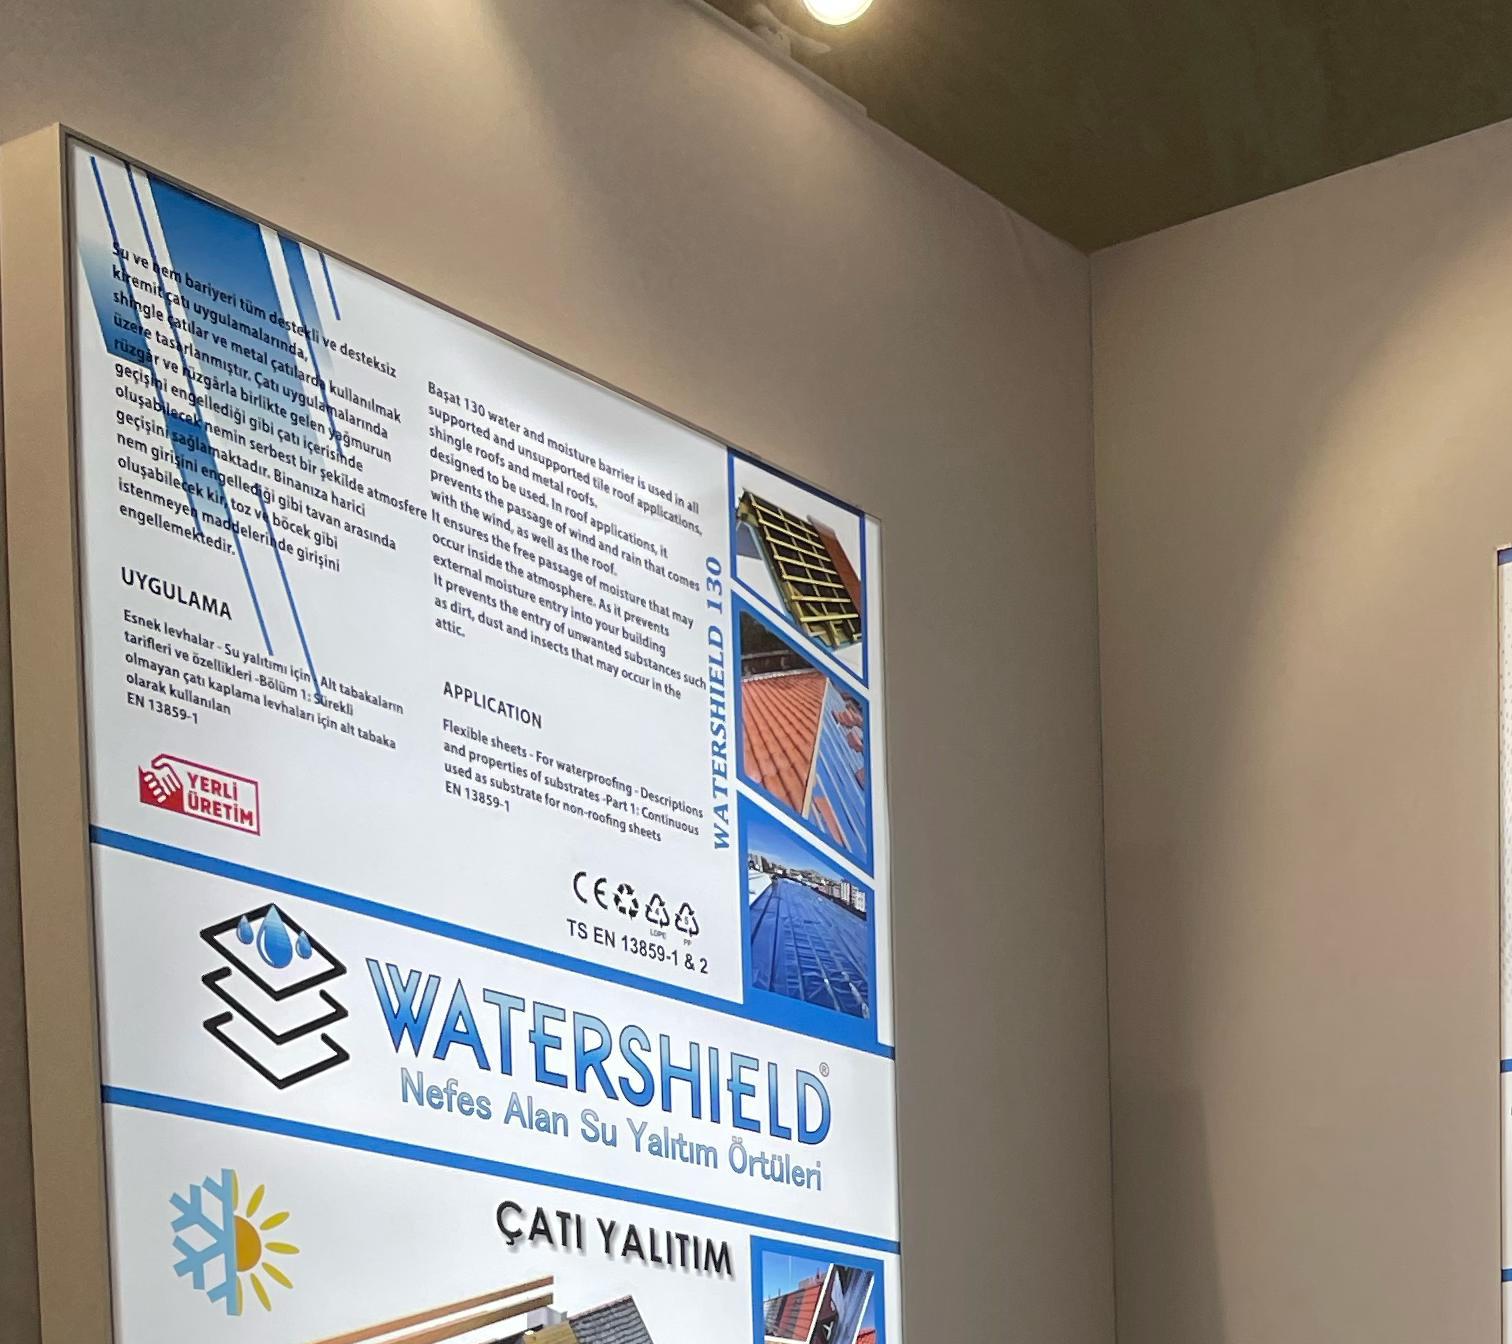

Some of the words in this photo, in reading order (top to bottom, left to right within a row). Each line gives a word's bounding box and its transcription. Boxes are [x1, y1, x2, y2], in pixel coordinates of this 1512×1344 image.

[114, 313, 151, 339] üzere
[254, 371, 279, 392] Çatı
[203, 422, 246, 446] nemin
[250, 440, 296, 466] serbest
[300, 457, 316, 474] bir
[321, 468, 364, 493] şekilde
[367, 486, 427, 517] atmosfere
[428, 382, 460, 406] Başat
[466, 399, 485, 417] 130
[488, 412, 520, 433] water
[524, 428, 544, 444] and
[548, 439, 595, 467] moisture
[599, 459, 634, 484] barrier
[638, 476, 645, 489] is
[648, 484, 672, 501] used
[675, 493, 684, 507] in
[688, 501, 699, 514] all
[428, 405, 490, 440] supported
[494, 435, 515, 451] and
[518, 445, 590, 484] unsupported
[593, 476, 610, 493] tile
[613, 487, 634, 504] roof
[638, 499, 703, 537] applications,
[117, 434, 147, 453] nem
[151, 447, 197, 473] girişini
[279, 496, 302, 512] gibi
[306, 504, 340, 527] tavan
[344, 521, 396, 548] arasında
[430, 470, 482, 499] prevents
[485, 491, 504, 508] the
[507, 502, 552, 528] passage
[556, 523, 566, 534] of
[569, 529, 595, 546] wind
[599, 541, 618, 556] and
[622, 551, 641, 566] rain
[645, 558, 665, 576] that
[668, 570, 700, 590] comes
[121, 567, 232, 619] UYGULAMA
[432, 533, 464, 553] occur
[468, 545, 502, 568] inside
[506, 560, 524, 577] the
[527, 571, 594, 605] atmosphere.
[599, 597, 611, 612] As
[614, 603, 621, 616] it
[624, 610, 669, 635] prevents
[706, 557, 723, 614] 130
[125, 652, 180, 679] olmayan
[183, 672, 205, 687] çatı
[209, 677, 260, 704] kaplama
[264, 695, 314, 722] levhaları
[317, 712, 337, 729] için
[341, 721, 354, 735] alt
[358, 726, 396, 748] tabaka
[126, 673, 165, 694] olarak
[169, 684, 231, 714] kullanılan
[127, 691, 144, 708] EN
[150, 698, 198, 724] 13859-1
[443, 681, 543, 728] APPLICATION
[708, 624, 730, 850] WATERSHIELD
[188, 772, 238, 800] YERLİ
[188, 792, 253, 826] ÜRETİM
[445, 781, 461, 796] EN
[466, 787, 510, 811] 13859-1
[445, 764, 472, 780] used
[475, 774, 487, 785] as
[490, 779, 542, 803] substrate
[545, 794, 560, 809] for
[563, 802, 626, 832] non-roofing
[629, 822, 662, 841] sheets
[573, 871, 608, 910] CE
[566, 918, 587, 939] TS
[594, 927, 615, 948] EN
[622, 935, 678, 966] 13859-1
[685, 954, 695, 970] &
[700, 958, 708, 974] 2
[365, 957, 831, 1145] WATERSHIELD
[402, 1068, 491, 1120] Nefes
[504, 1092, 568, 1137] Alan
[580, 1109, 617, 1147] Su
[626, 1117, 718, 1169] Yalıtım
[729, 1136, 822, 1191] Örtüleri
[496, 1200, 582, 1249] ÇATI
[597, 1217, 732, 1275] YALITIM
